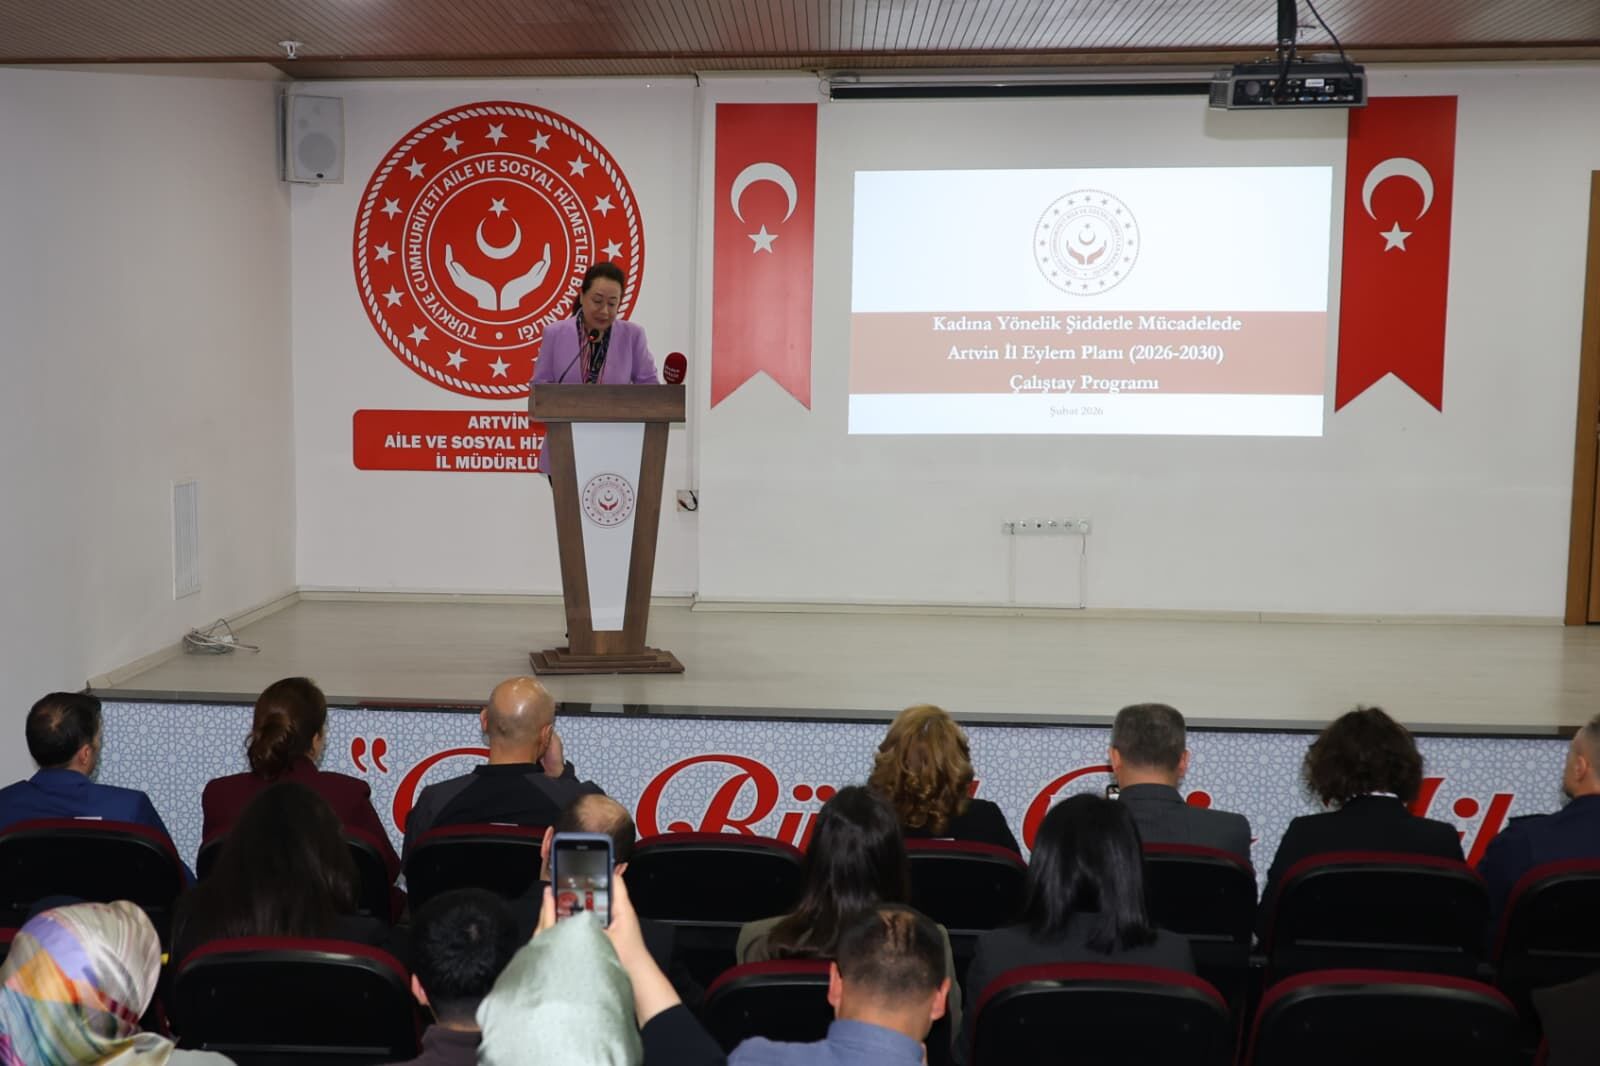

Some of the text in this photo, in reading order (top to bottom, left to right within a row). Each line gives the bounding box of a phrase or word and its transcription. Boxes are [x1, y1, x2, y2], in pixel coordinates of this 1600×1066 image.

[475, 160, 496, 174] VE
[499, 159, 555, 192] SOSYAL
[443, 164, 475, 191] AİLE
[408, 184, 444, 292] CUMHURİYETİ
[553, 187, 589, 275] HİZMETLER
[423, 291, 477, 340] TÜRKİYE
[933, 315, 1242, 334] Kadına Yönelik Şiddetle Mücadelede
[947, 343, 1224, 364] Artvin İl Eylem Planı (2026-2030)
[1009, 374, 1159, 394] Çalıştay Programı
[467, 412, 529, 429] ARTVİN
[384, 431, 545, 450] AİLE VE SOSYAL HİZ
[436, 452, 538, 470] İL MÜDÜRLÜ
